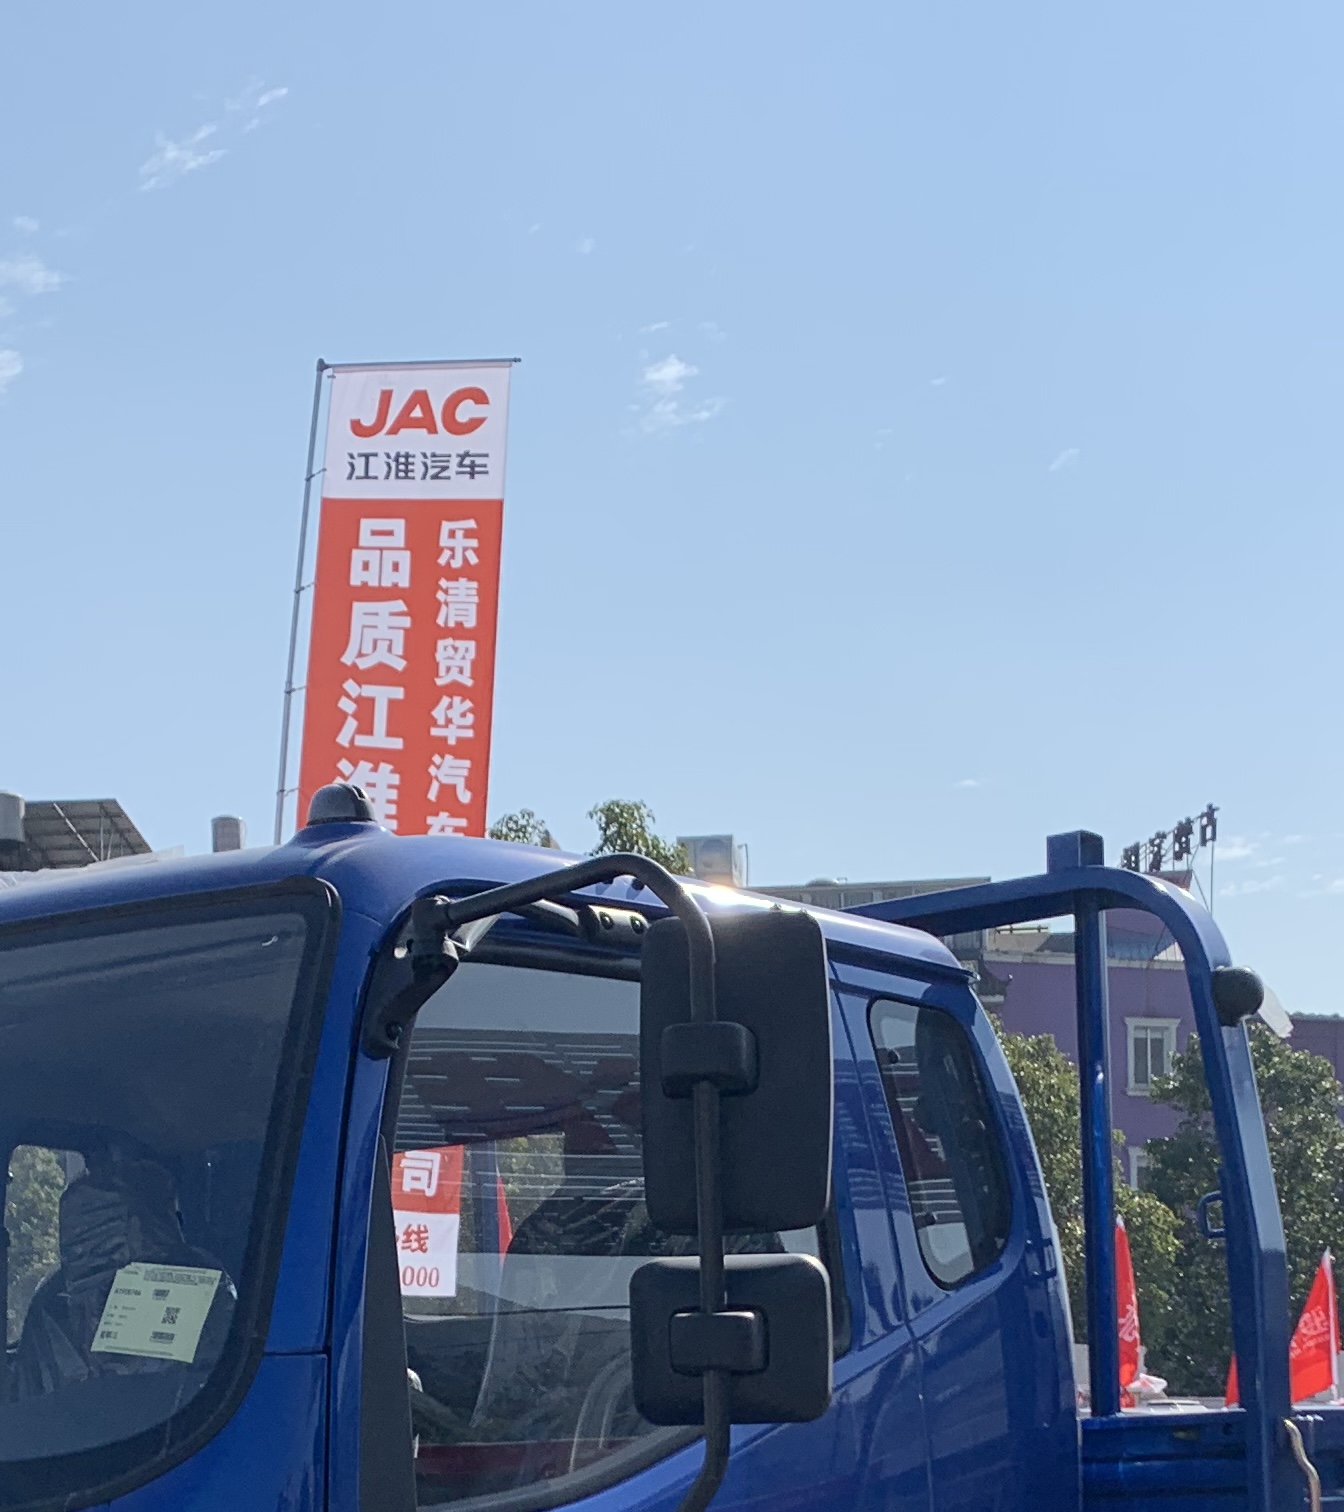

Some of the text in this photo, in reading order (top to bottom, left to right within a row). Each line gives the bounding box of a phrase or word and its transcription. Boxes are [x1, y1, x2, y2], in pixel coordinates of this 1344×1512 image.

[349, 386, 490, 438] JAC
[346, 450, 489, 481] 江淮汽车
[400, 1150, 441, 1197] 司
[395, 1223, 429, 1254] 线
